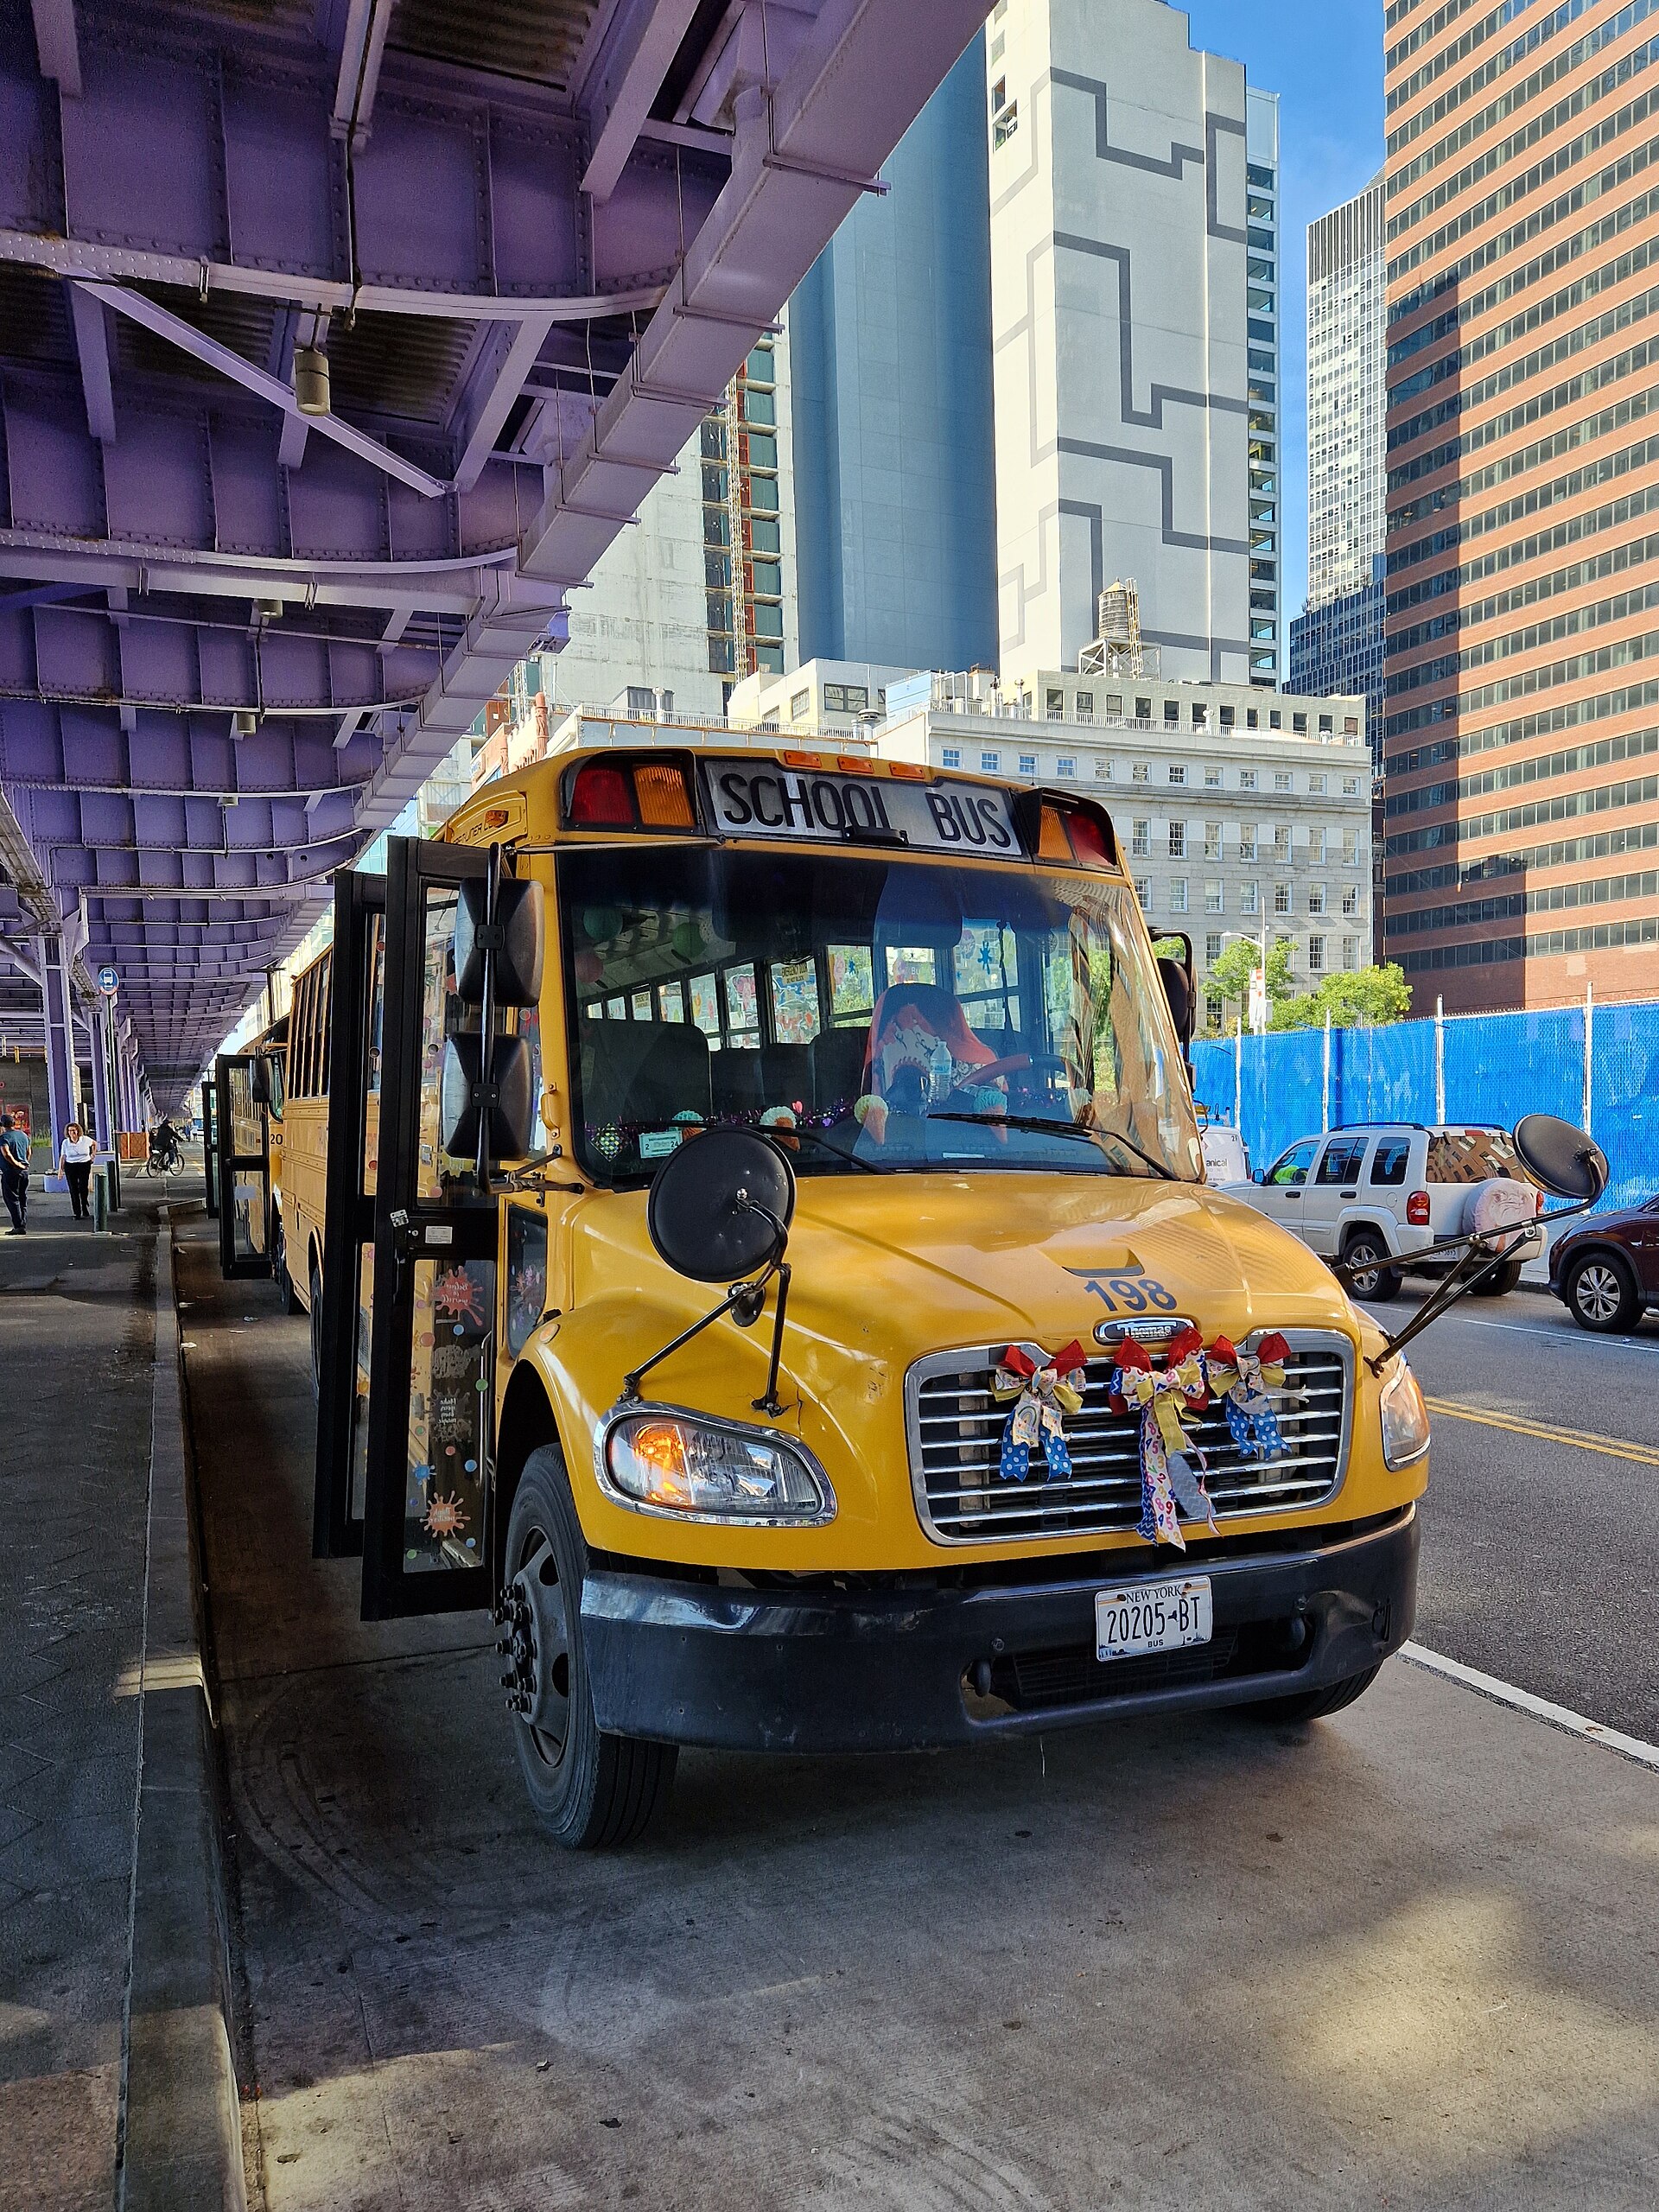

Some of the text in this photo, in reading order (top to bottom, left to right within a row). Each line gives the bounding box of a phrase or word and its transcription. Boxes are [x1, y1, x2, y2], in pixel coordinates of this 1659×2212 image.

[720, 773, 1011, 849] SCHOOL BUS
[270, 1134, 283, 1146] 20
[1084, 1279, 1178, 1312] 198
[1116, 1321, 1177, 1338] Thomas
[1126, 1585, 1182, 1604] NEW YORK
[1147, 1639, 1164, 1648] BUS
